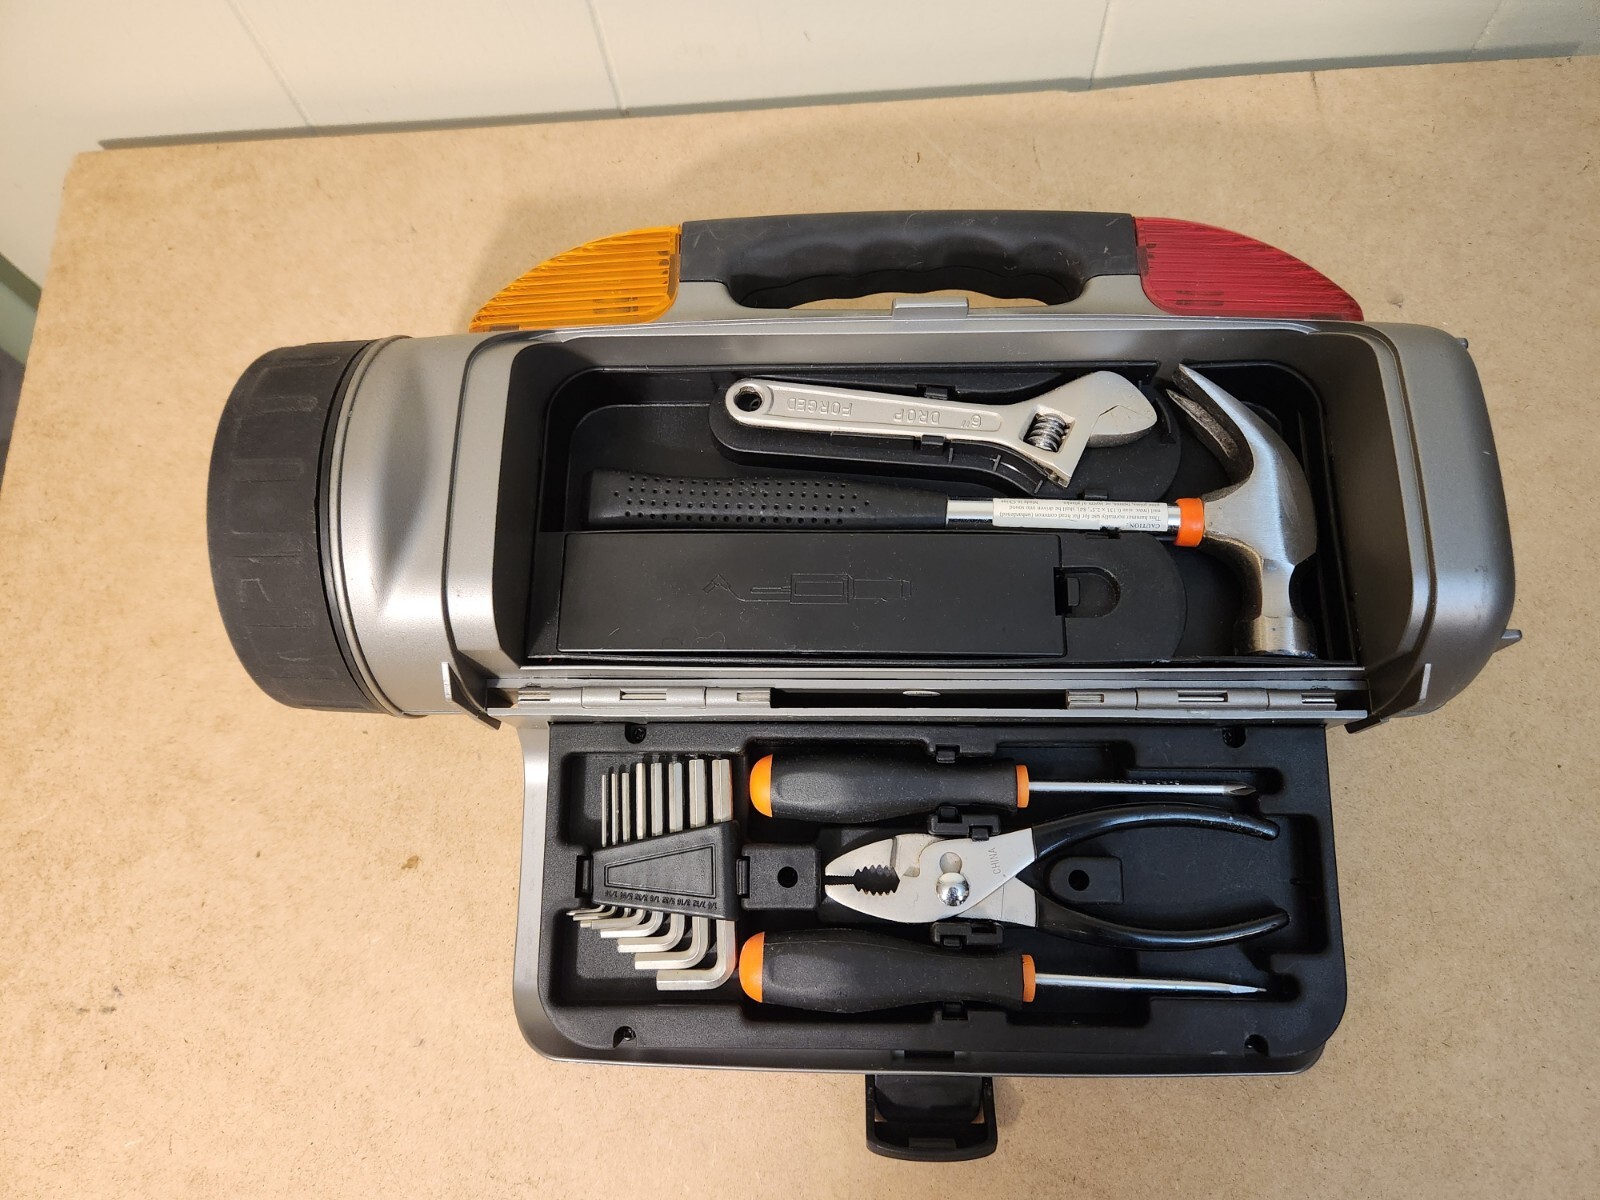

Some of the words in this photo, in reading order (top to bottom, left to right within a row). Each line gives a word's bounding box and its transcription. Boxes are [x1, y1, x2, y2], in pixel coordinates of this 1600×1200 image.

[786, 397, 853, 418] FORGED
[893, 408, 941, 425] DROP
[960, 413, 982, 429] 6"
[988, 847, 1001, 875] CHINA
